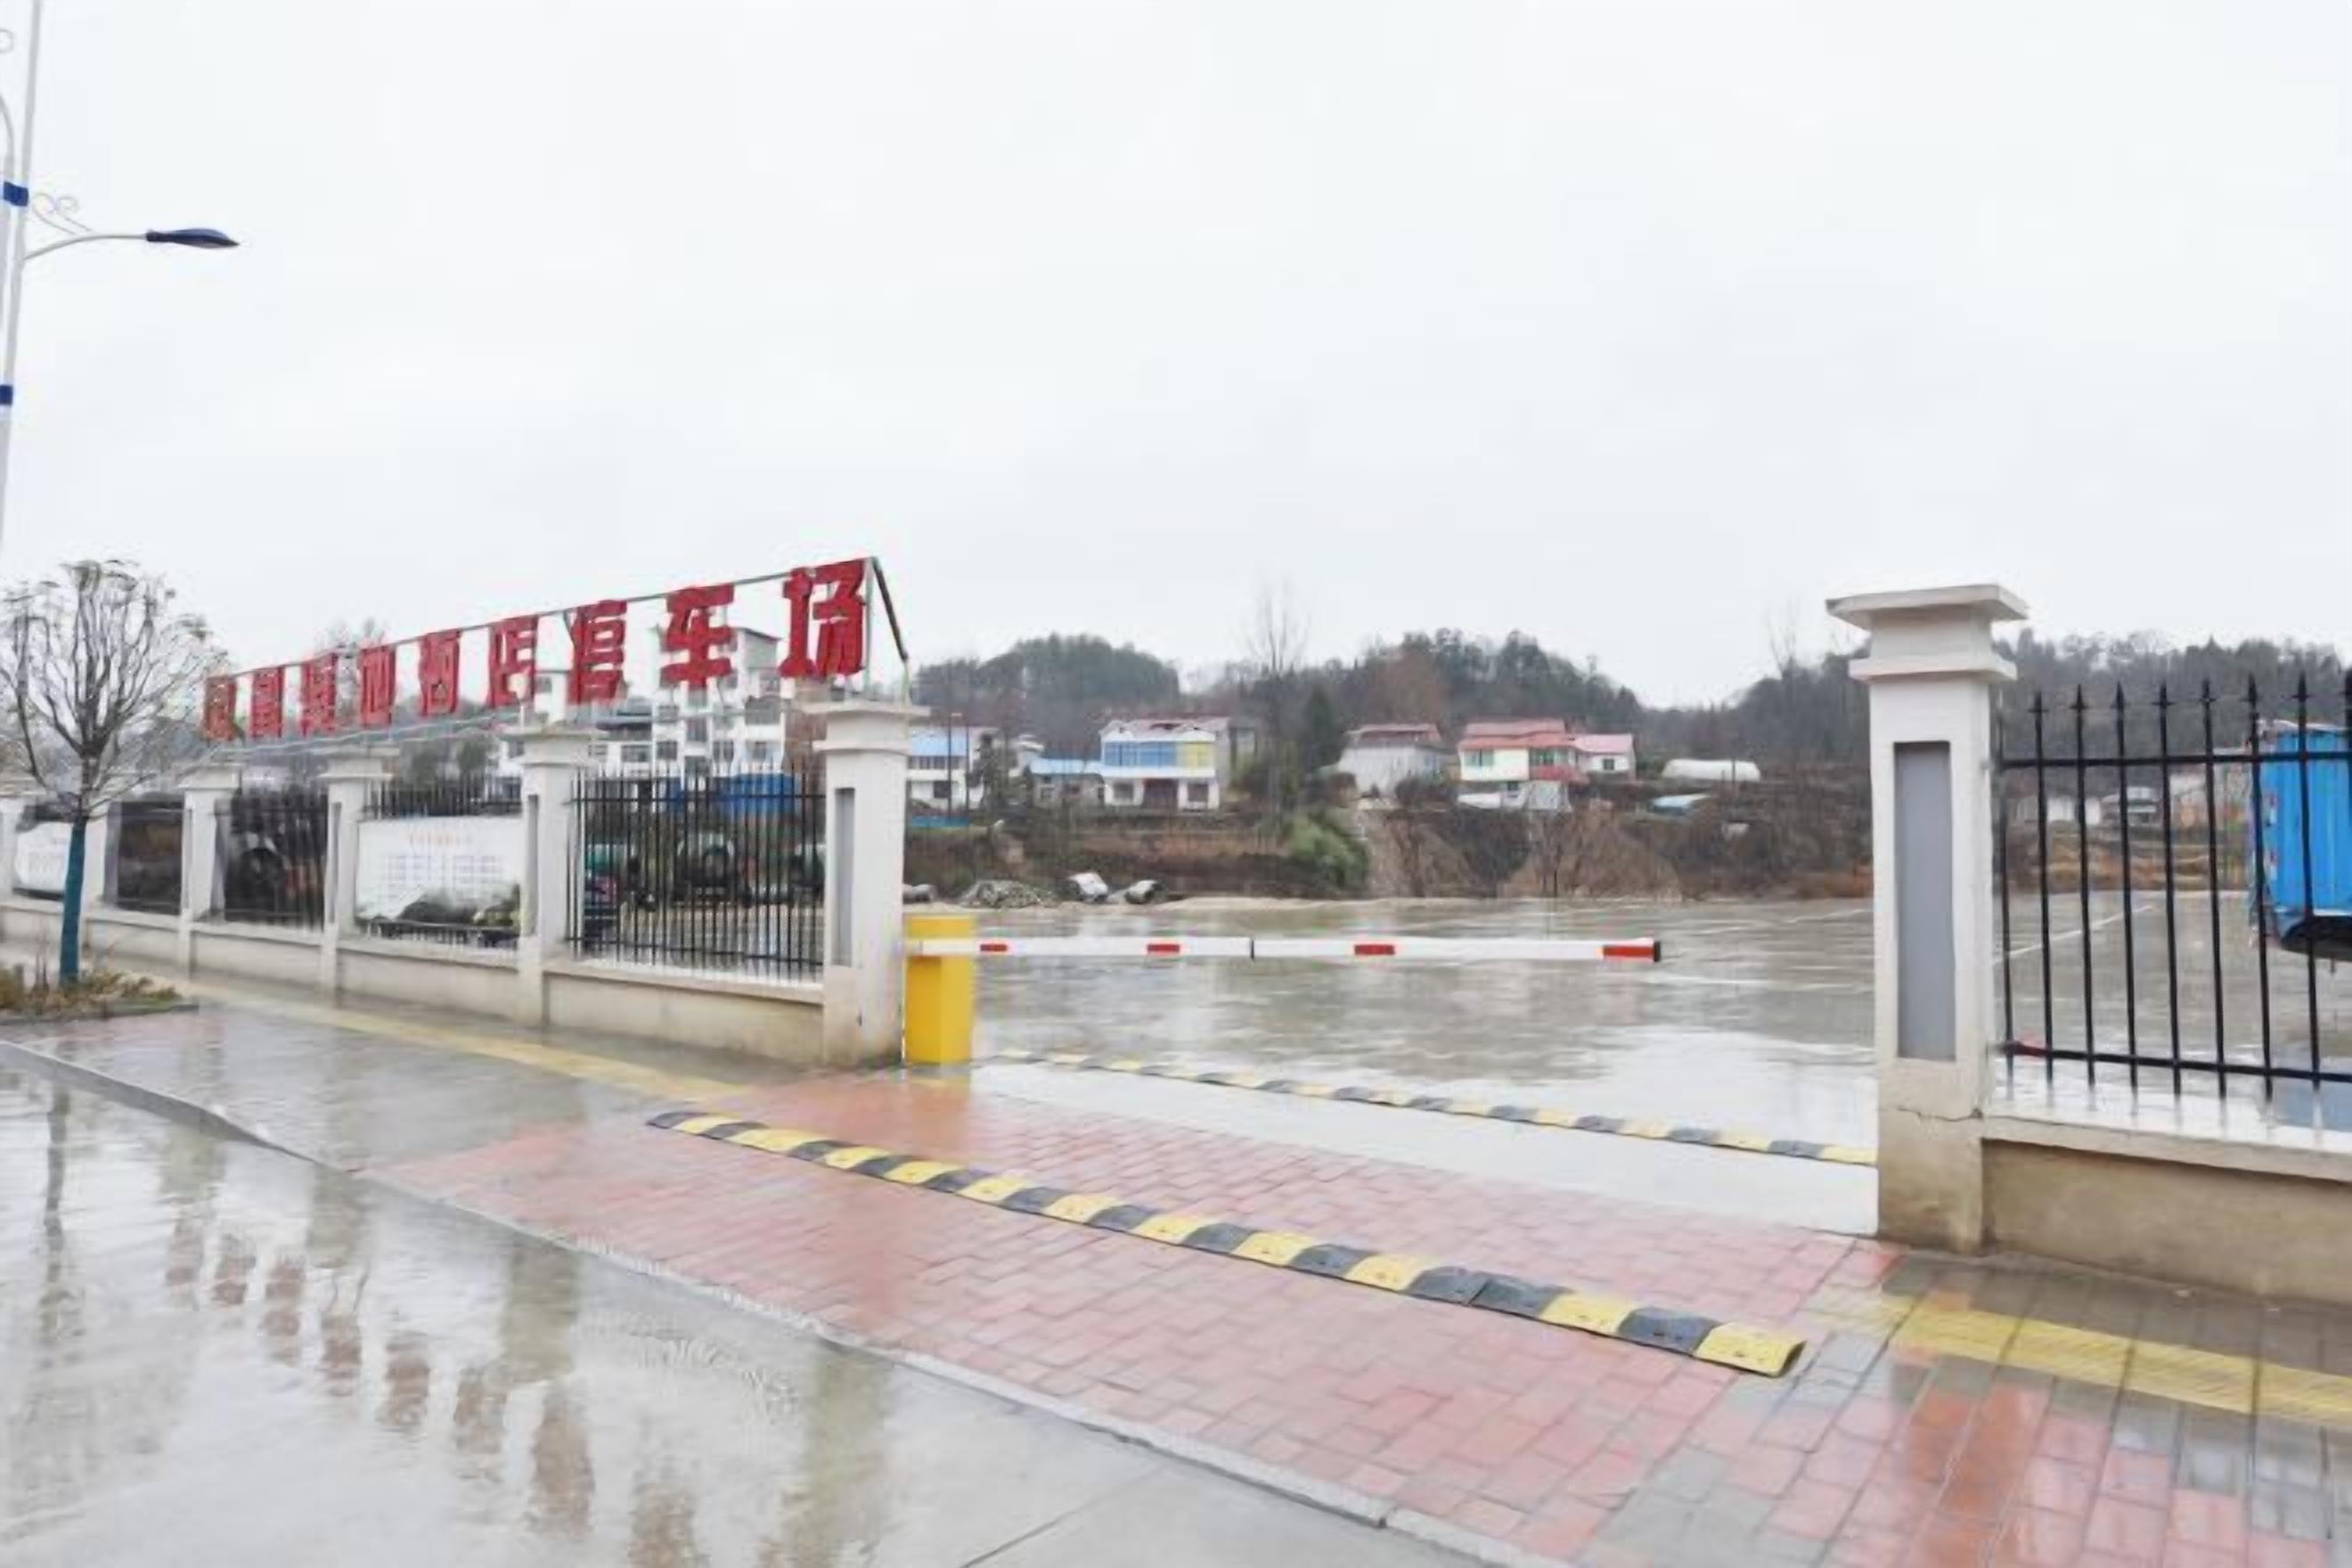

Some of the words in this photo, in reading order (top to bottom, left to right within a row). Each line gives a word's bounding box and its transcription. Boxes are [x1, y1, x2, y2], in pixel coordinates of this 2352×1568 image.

[203, 559, 866, 741] 酒店停车场
